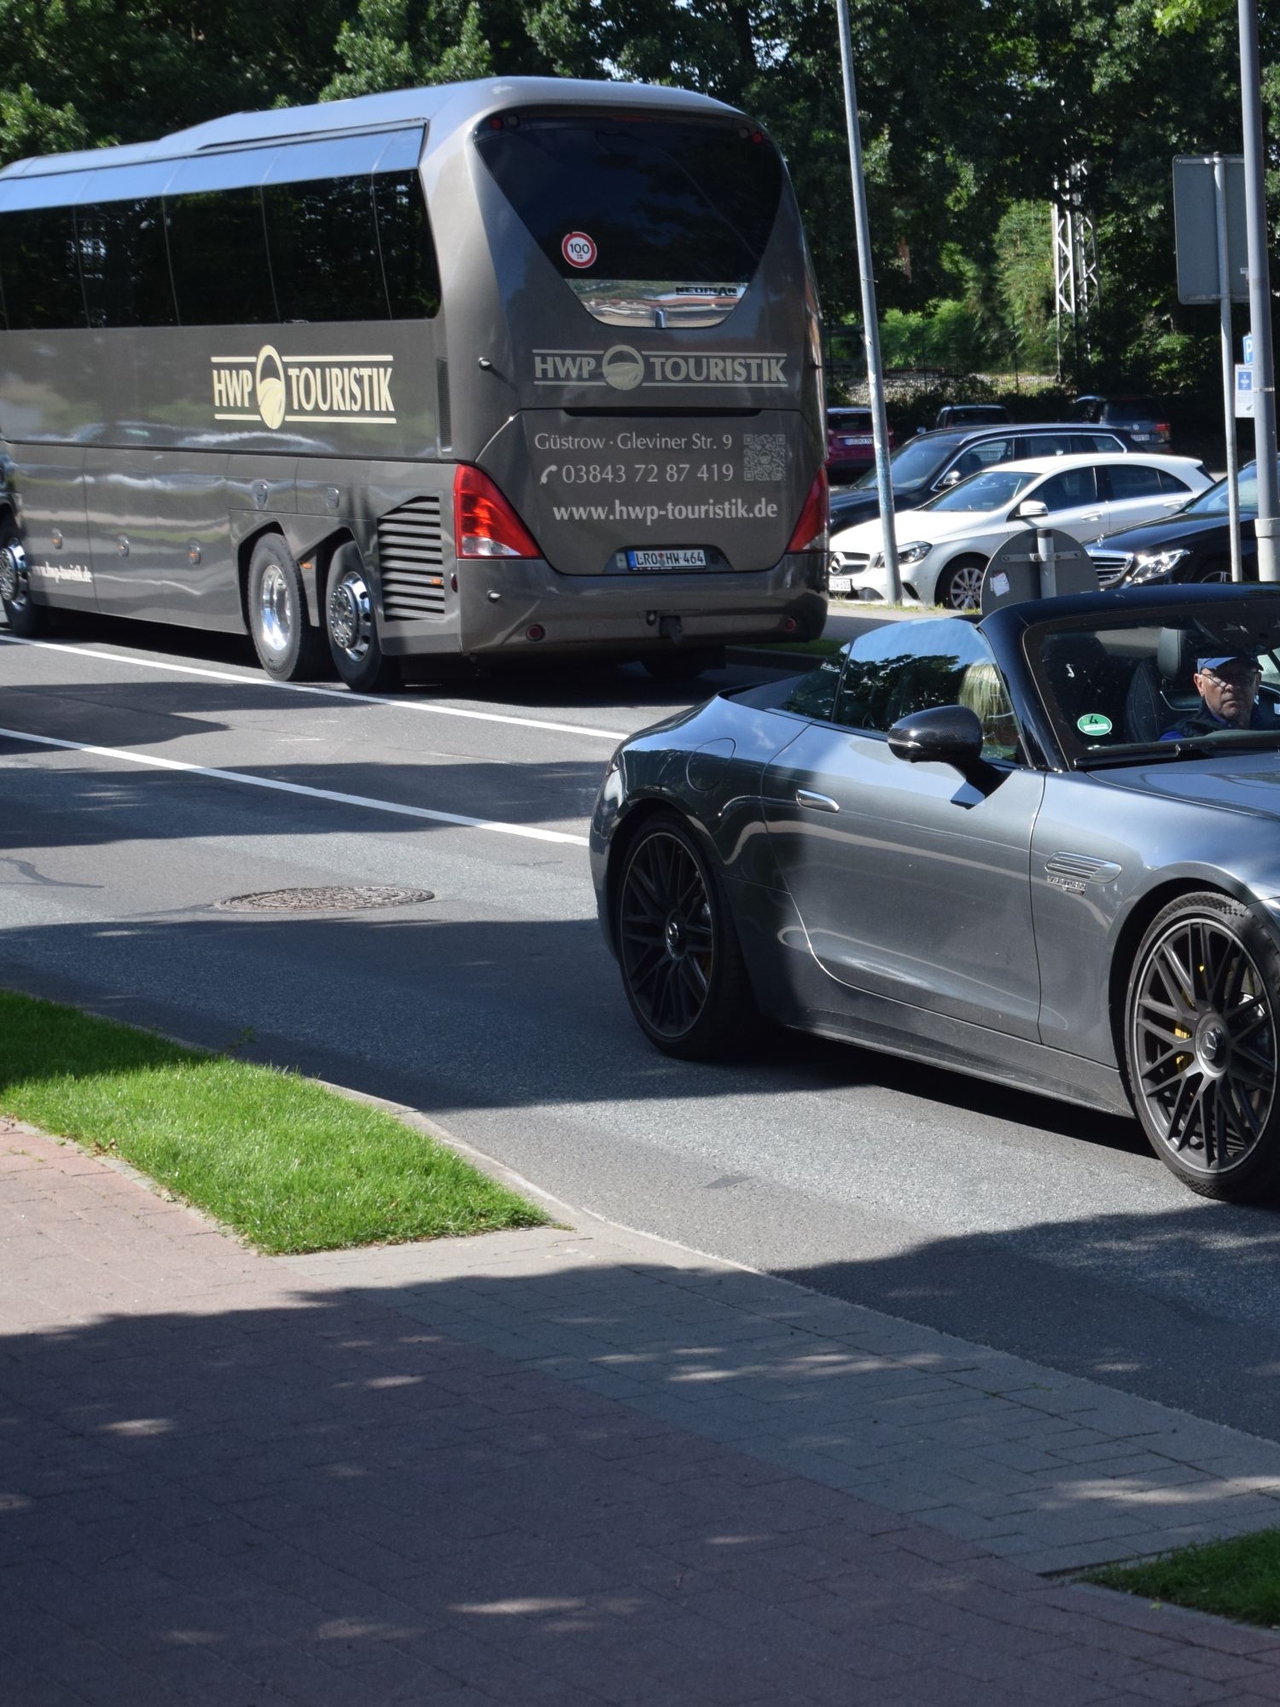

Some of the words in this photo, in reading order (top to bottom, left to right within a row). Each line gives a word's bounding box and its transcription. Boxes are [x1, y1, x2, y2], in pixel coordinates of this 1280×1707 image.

[569, 243, 590, 254] 100
[675, 286, 737, 295] NEOPLAN
[534, 356, 597, 379] HWP
[650, 357, 787, 382] TOURISTIK
[213, 369, 252, 408] HWP
[287, 366, 395, 411] TOURISTIK
[534, 433, 606, 449] Güstrow
[617, 432, 687, 450] Gleviner
[692, 433, 717, 449] Str.
[722, 434, 732, 450] 9
[562, 464, 626, 483] 03843
[635, 464, 658, 482] 72
[666, 464, 690, 482] 87
[697, 463, 734, 482] 419
[553, 498, 778, 526] www.hwp-touristik.de
[635, 552, 658, 565] LRO
[665, 552, 679, 565] HW
[683, 551, 704, 564] 464
[1089, 715, 1098, 724] 4
